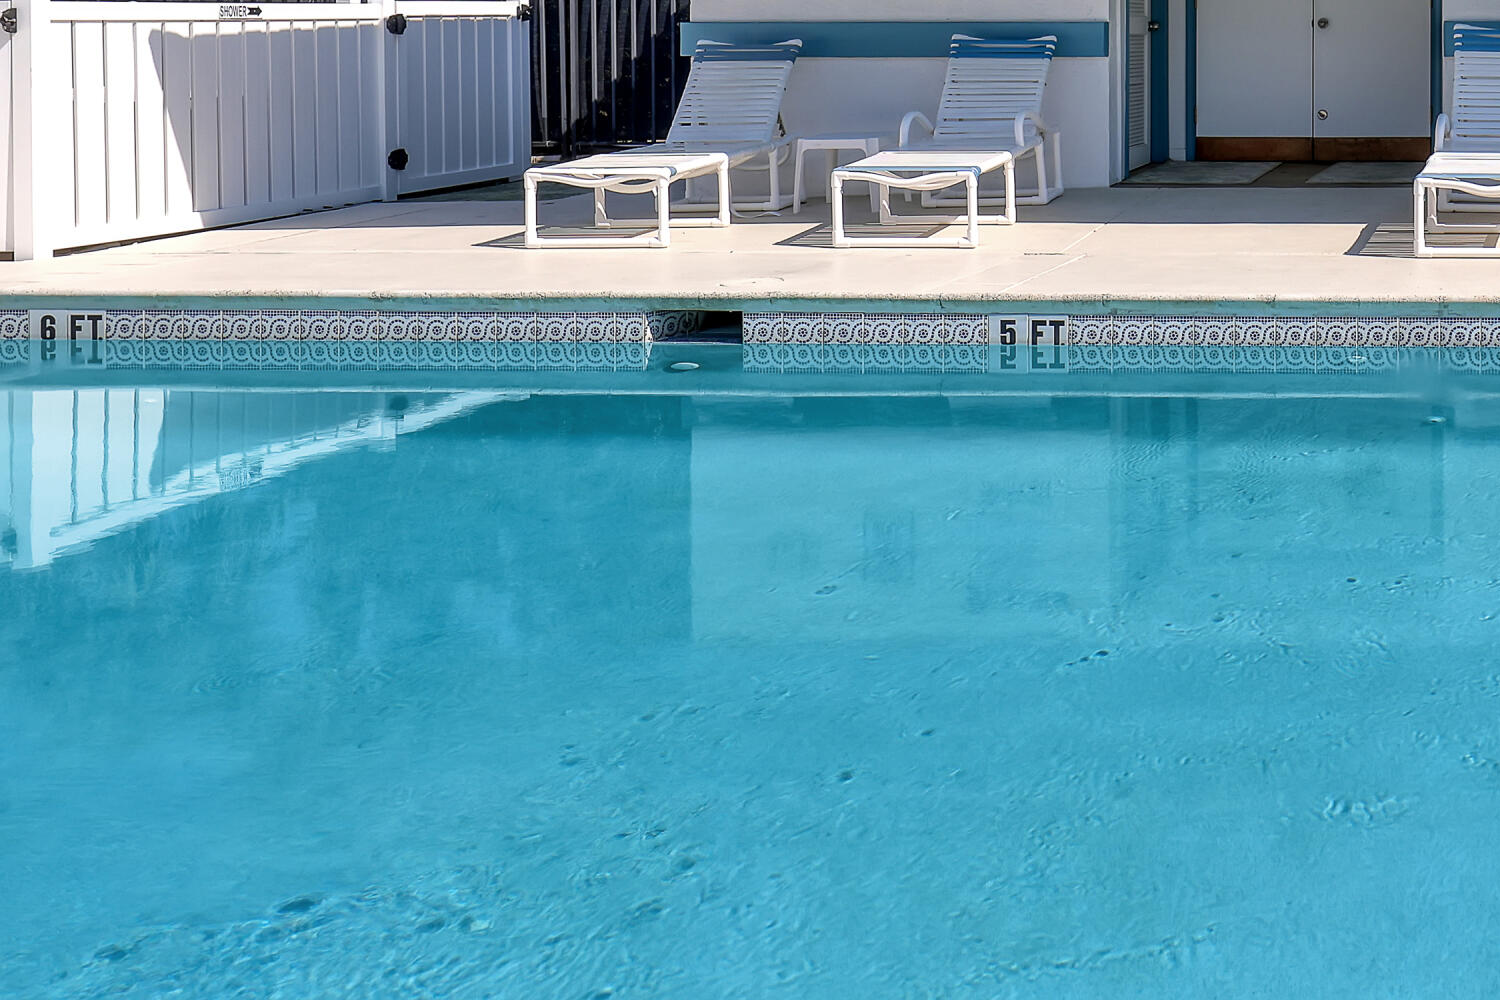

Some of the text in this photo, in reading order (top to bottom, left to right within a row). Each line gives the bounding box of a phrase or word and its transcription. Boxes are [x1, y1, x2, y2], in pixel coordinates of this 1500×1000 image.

[220, 5, 247, 17] SHOWER
[41, 315, 56, 340] 6
[1000, 320, 1016, 345] 5
